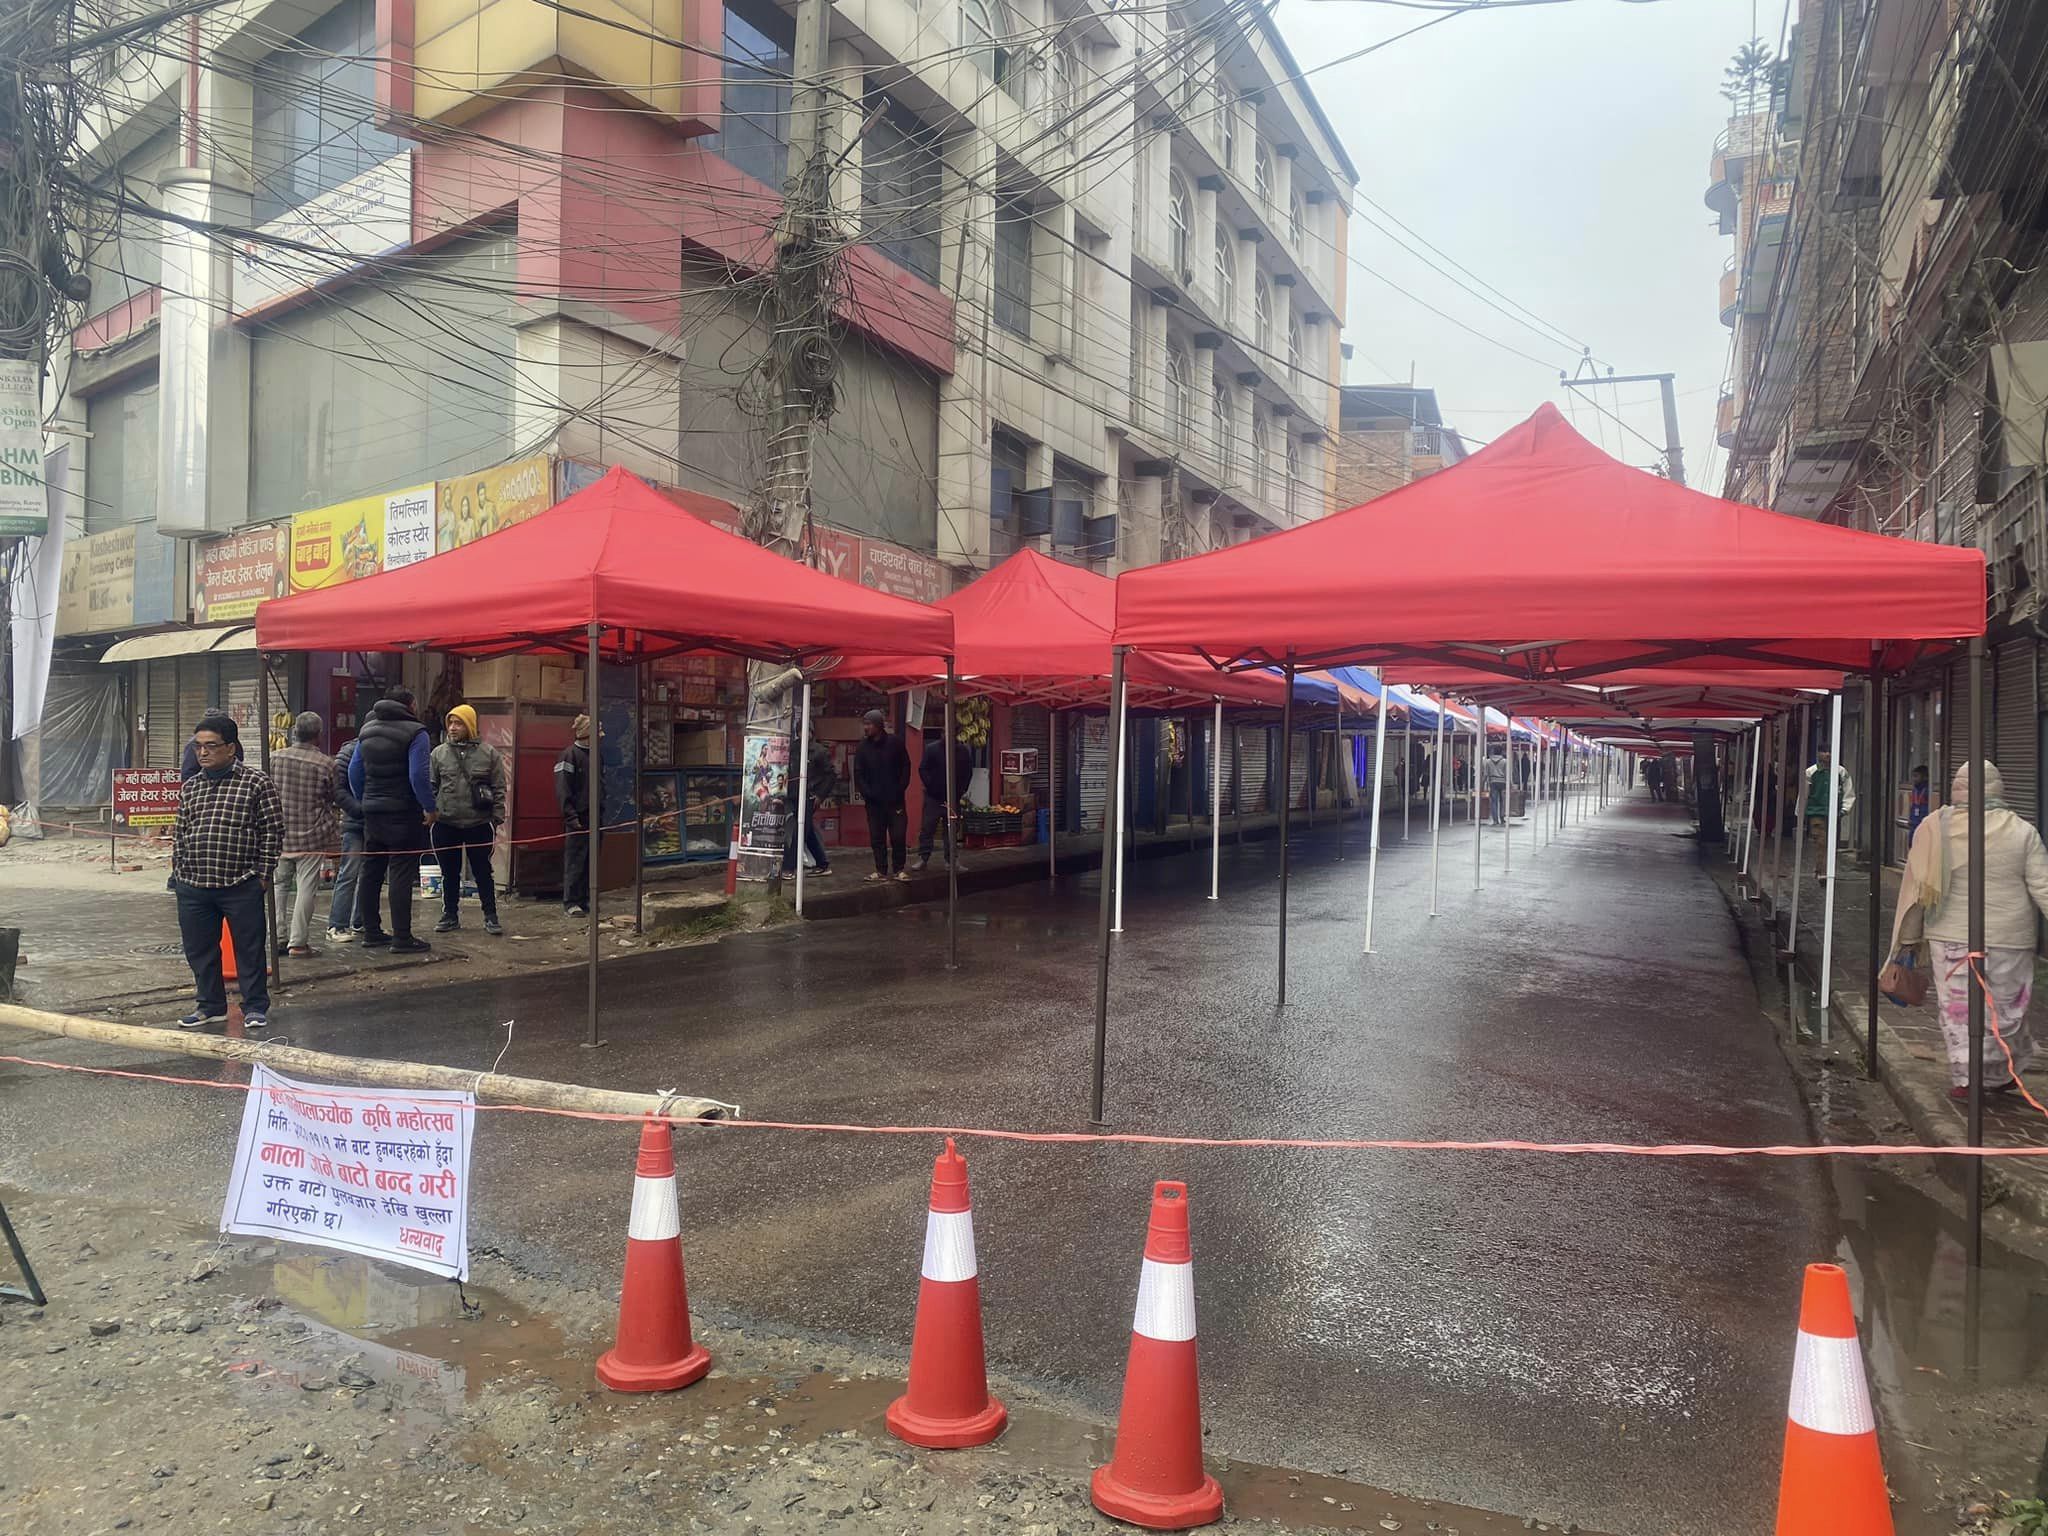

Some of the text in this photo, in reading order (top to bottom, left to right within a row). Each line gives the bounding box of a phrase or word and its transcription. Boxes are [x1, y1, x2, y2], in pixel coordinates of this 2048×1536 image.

[3, 416, 37, 430] Open
[387, 521, 430, 548] कोल्ड स्टोर
[125, 770, 140, 785] महा
[140, 770, 160, 785] लक्ष्मी
[117, 788, 138, 802] जेन्स
[140, 787, 160, 802] हेयर
[362, 1104, 392, 1133] कृषि
[396, 1106, 454, 1132] महोत्सव
[333, 1134, 347, 1153] गते
[260, 1142, 305, 1169] नाला
[338, 1161, 369, 1188] बाटो
[375, 1169, 412, 1195] बन्द
[419, 1168, 457, 1199] गरी
[263, 1174, 293, 1192] उक्त
[383, 1197, 409, 1218] देखि
[414, 1205, 453, 1226] खुल्ला
[266, 1198, 320, 1224] गरिएको
[398, 1226, 446, 1258] धन्यवाद
